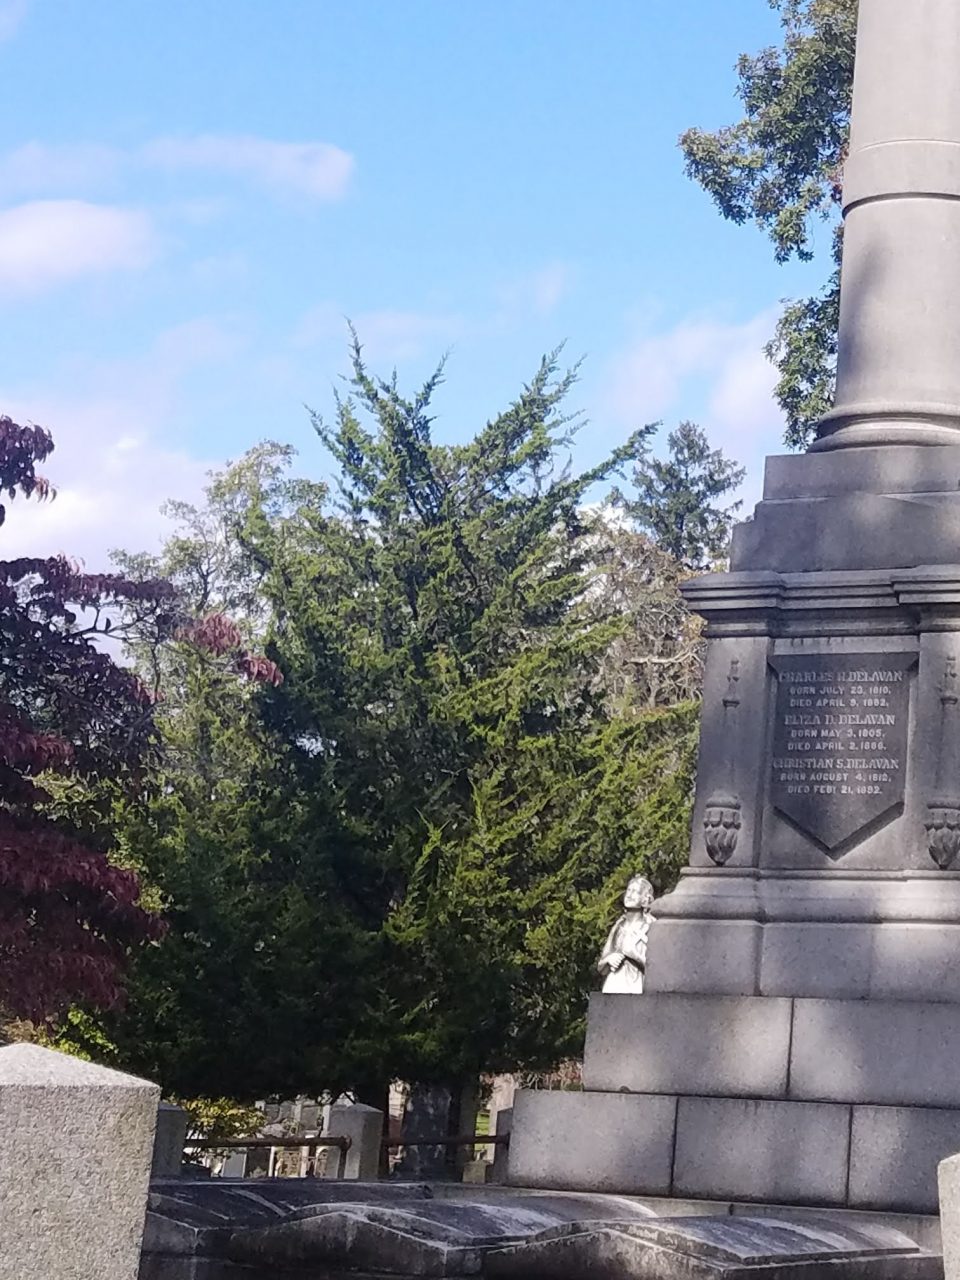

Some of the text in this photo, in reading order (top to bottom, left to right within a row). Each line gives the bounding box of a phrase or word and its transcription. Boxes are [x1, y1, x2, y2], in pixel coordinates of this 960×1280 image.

[847, 670, 903, 682] DELAVAN
[790, 686, 816, 695] BORN
[820, 686, 845, 695] JULY
[790, 699, 812, 707] DIED
[816, 699, 845, 707] APRIL
[784, 715, 820, 725] ELIZA
[838, 714, 896, 725] DELAVAN
[791, 729, 817, 738] BORN
[821, 729, 841, 738] MAY
[788, 742, 811, 751] DIED
[815, 742, 844, 751] APRIL
[773, 759, 833, 769] CHRISTIAN
[846, 758, 899, 769] DELAVAN
[780, 773, 806, 781] BORN
[810, 772, 849, 781] AUGUST
[787, 785, 810, 794] DIED
